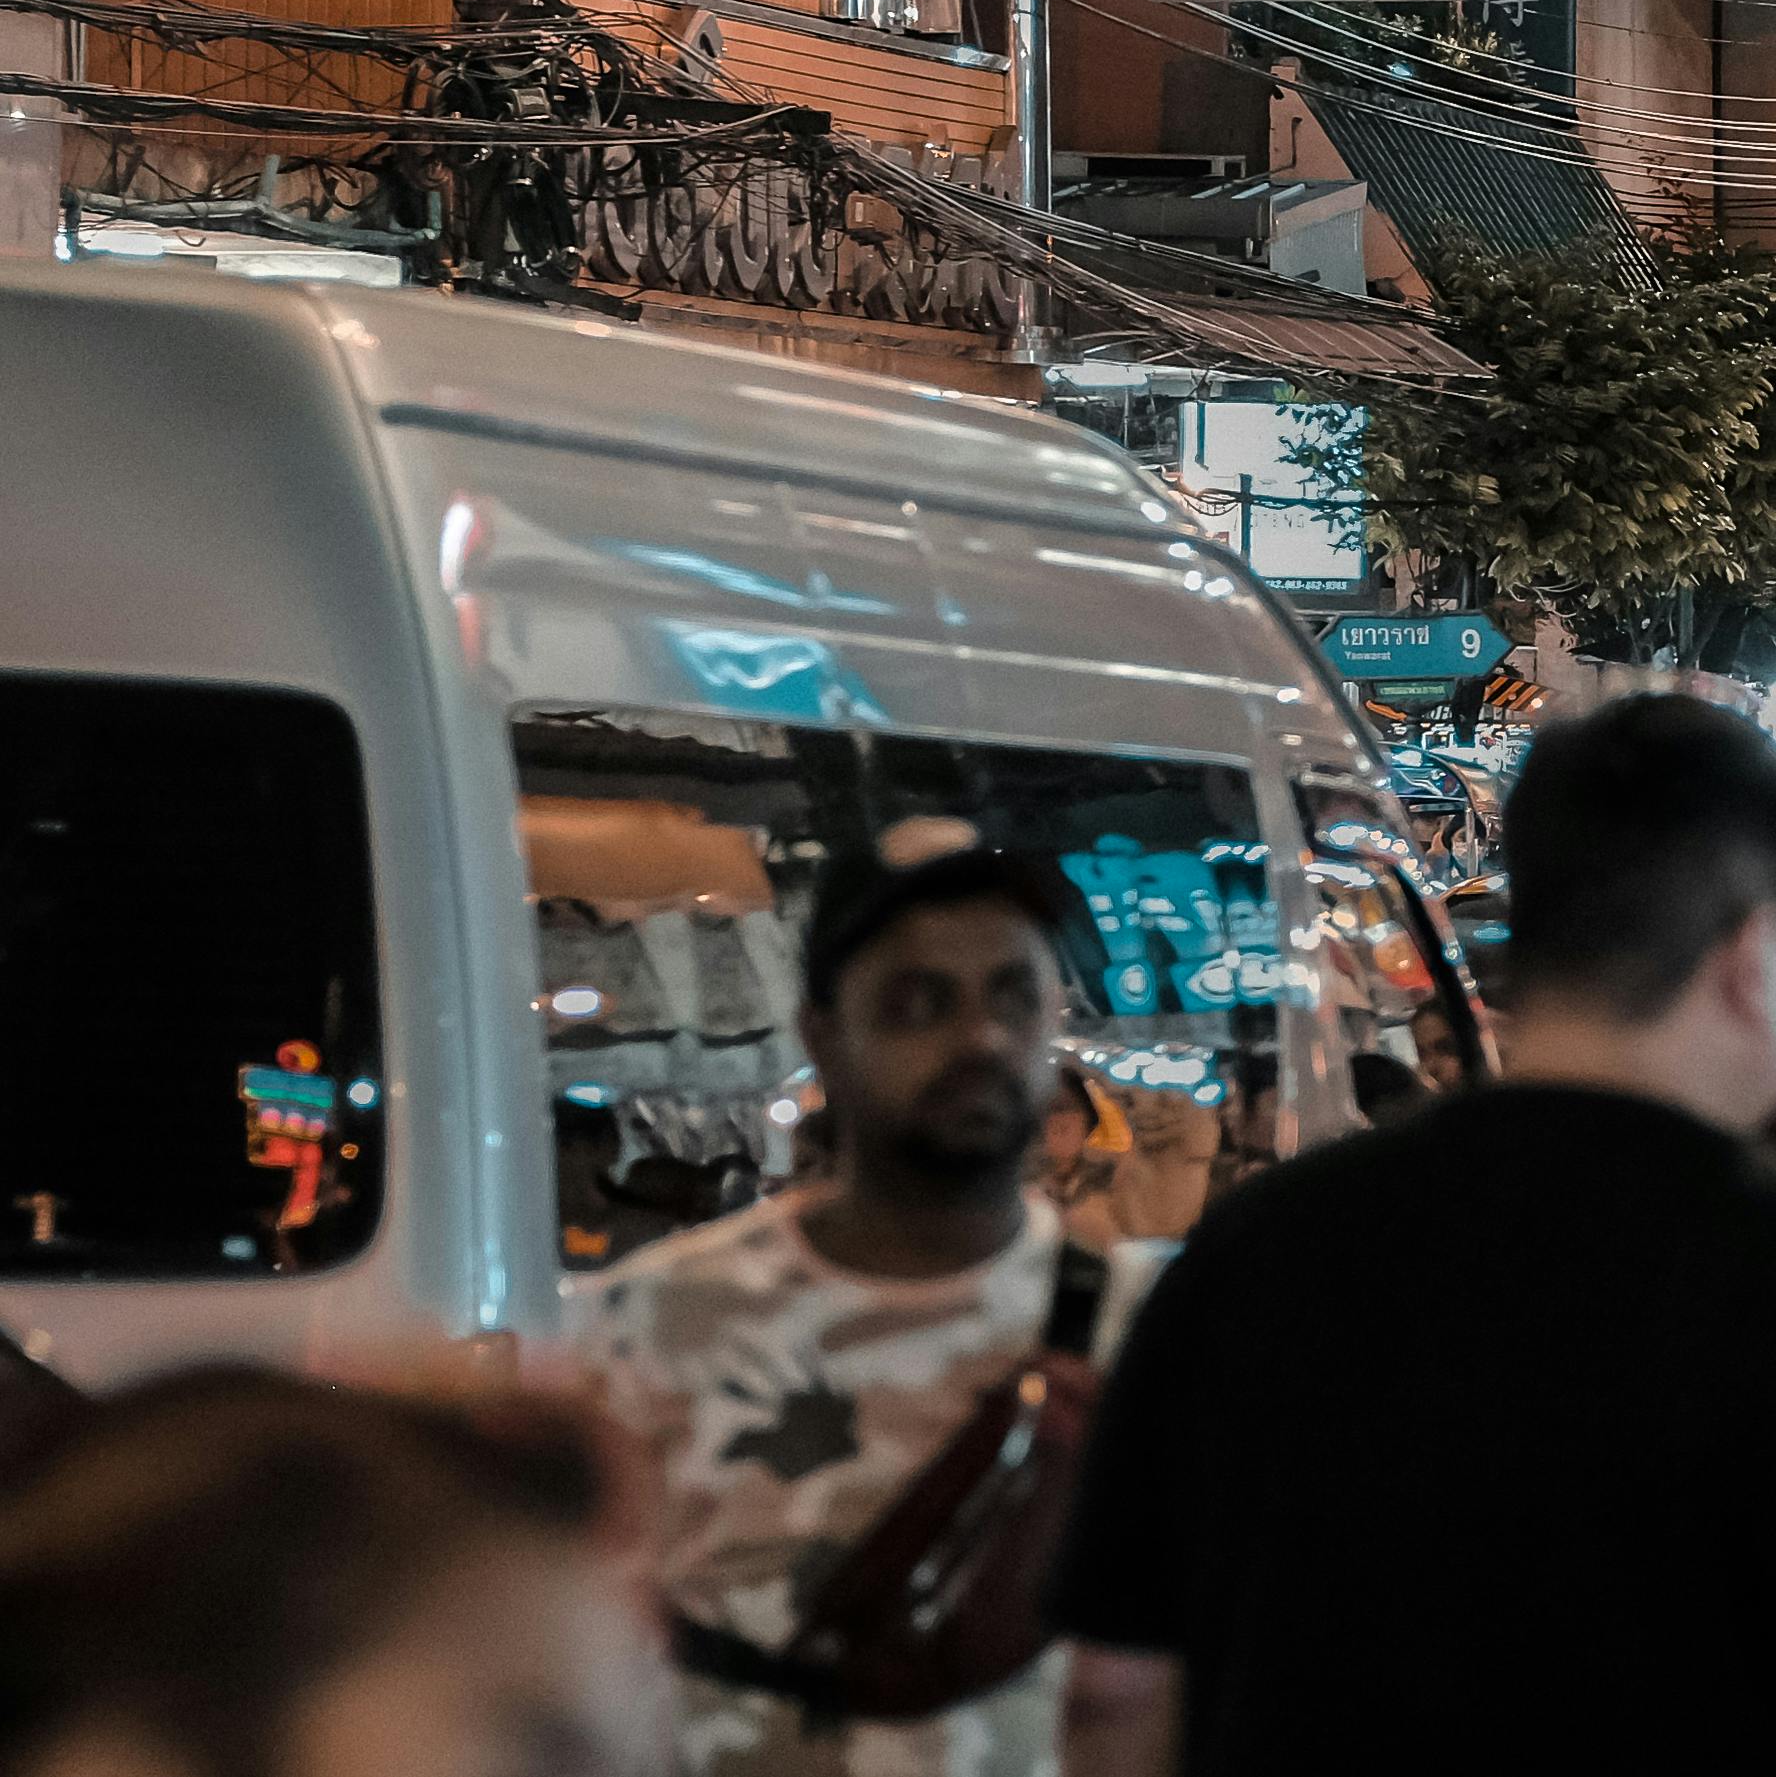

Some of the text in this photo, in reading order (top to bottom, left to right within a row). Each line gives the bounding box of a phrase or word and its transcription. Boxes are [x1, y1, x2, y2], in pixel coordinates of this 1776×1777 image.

[1341, 624, 1430, 646] เยาวราช
[1461, 628, 1481, 659] 9
